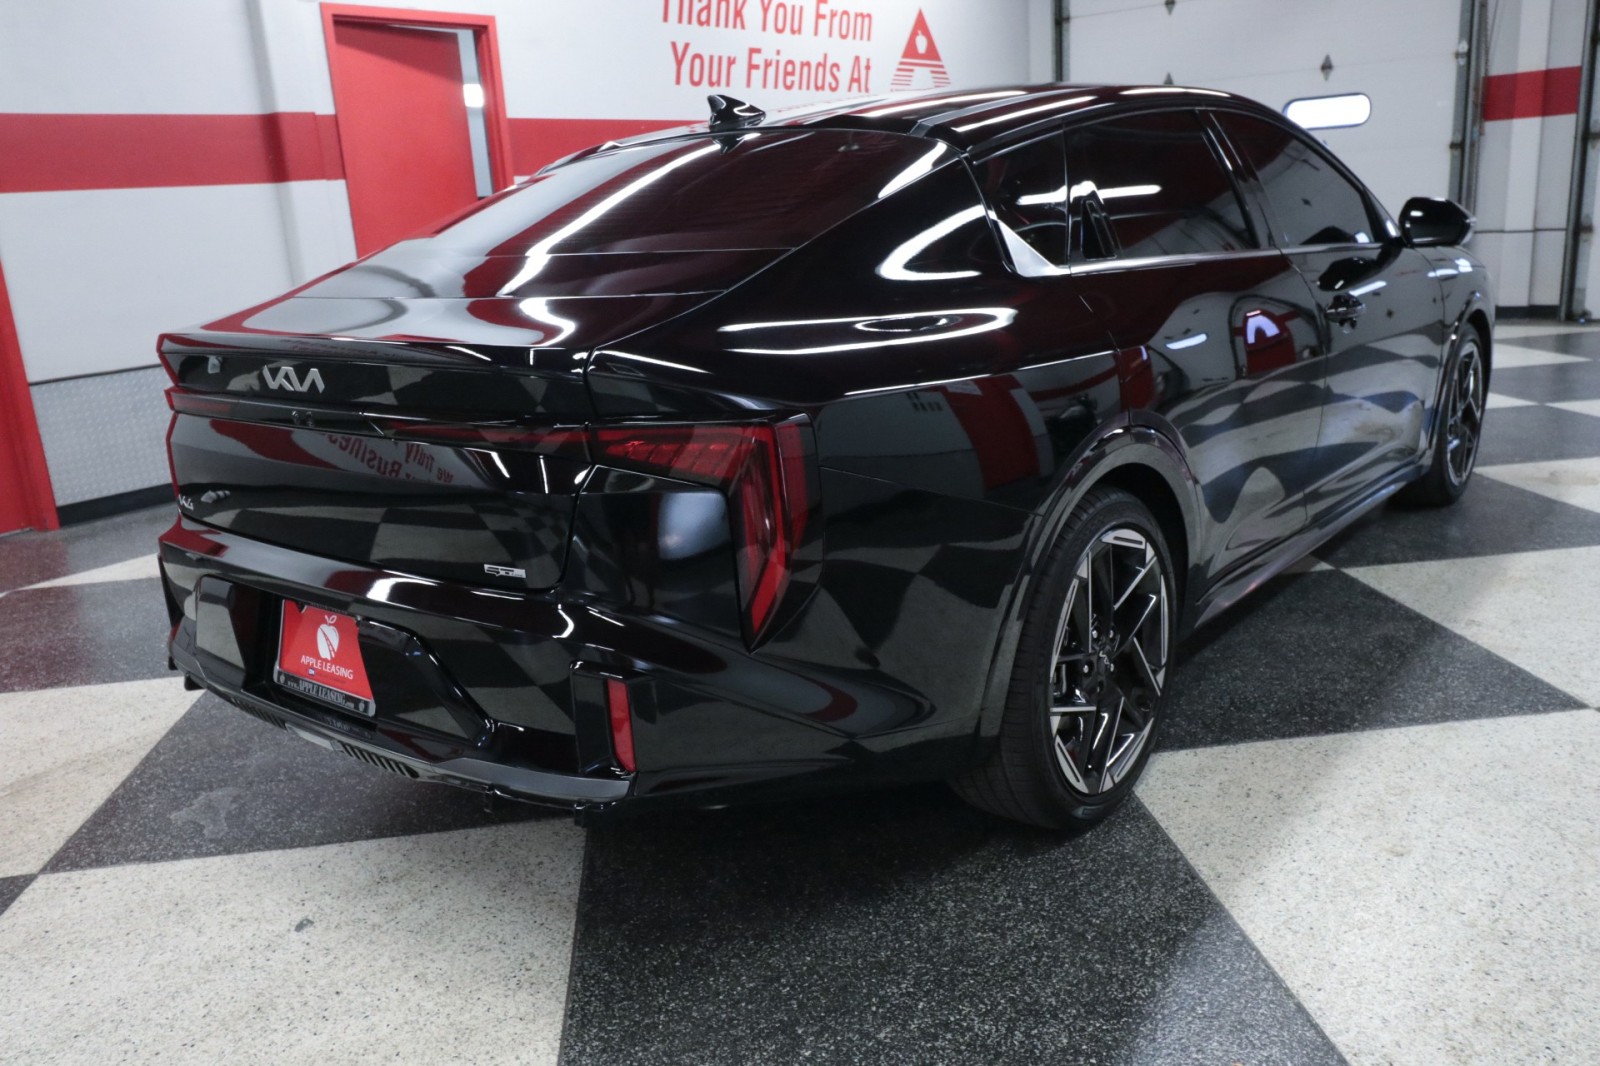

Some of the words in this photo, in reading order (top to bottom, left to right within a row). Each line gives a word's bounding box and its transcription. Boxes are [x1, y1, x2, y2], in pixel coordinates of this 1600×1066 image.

[760, 0, 804, 35] You
[813, 0, 873, 42] From
[670, 41, 736, 87] Your
[746, 47, 840, 92] Friends
[847, 55, 871, 93] At
[262, 364, 325, 394] KIA
[300, 655, 322, 670] APPLE
[322, 661, 354, 680] LEASING
